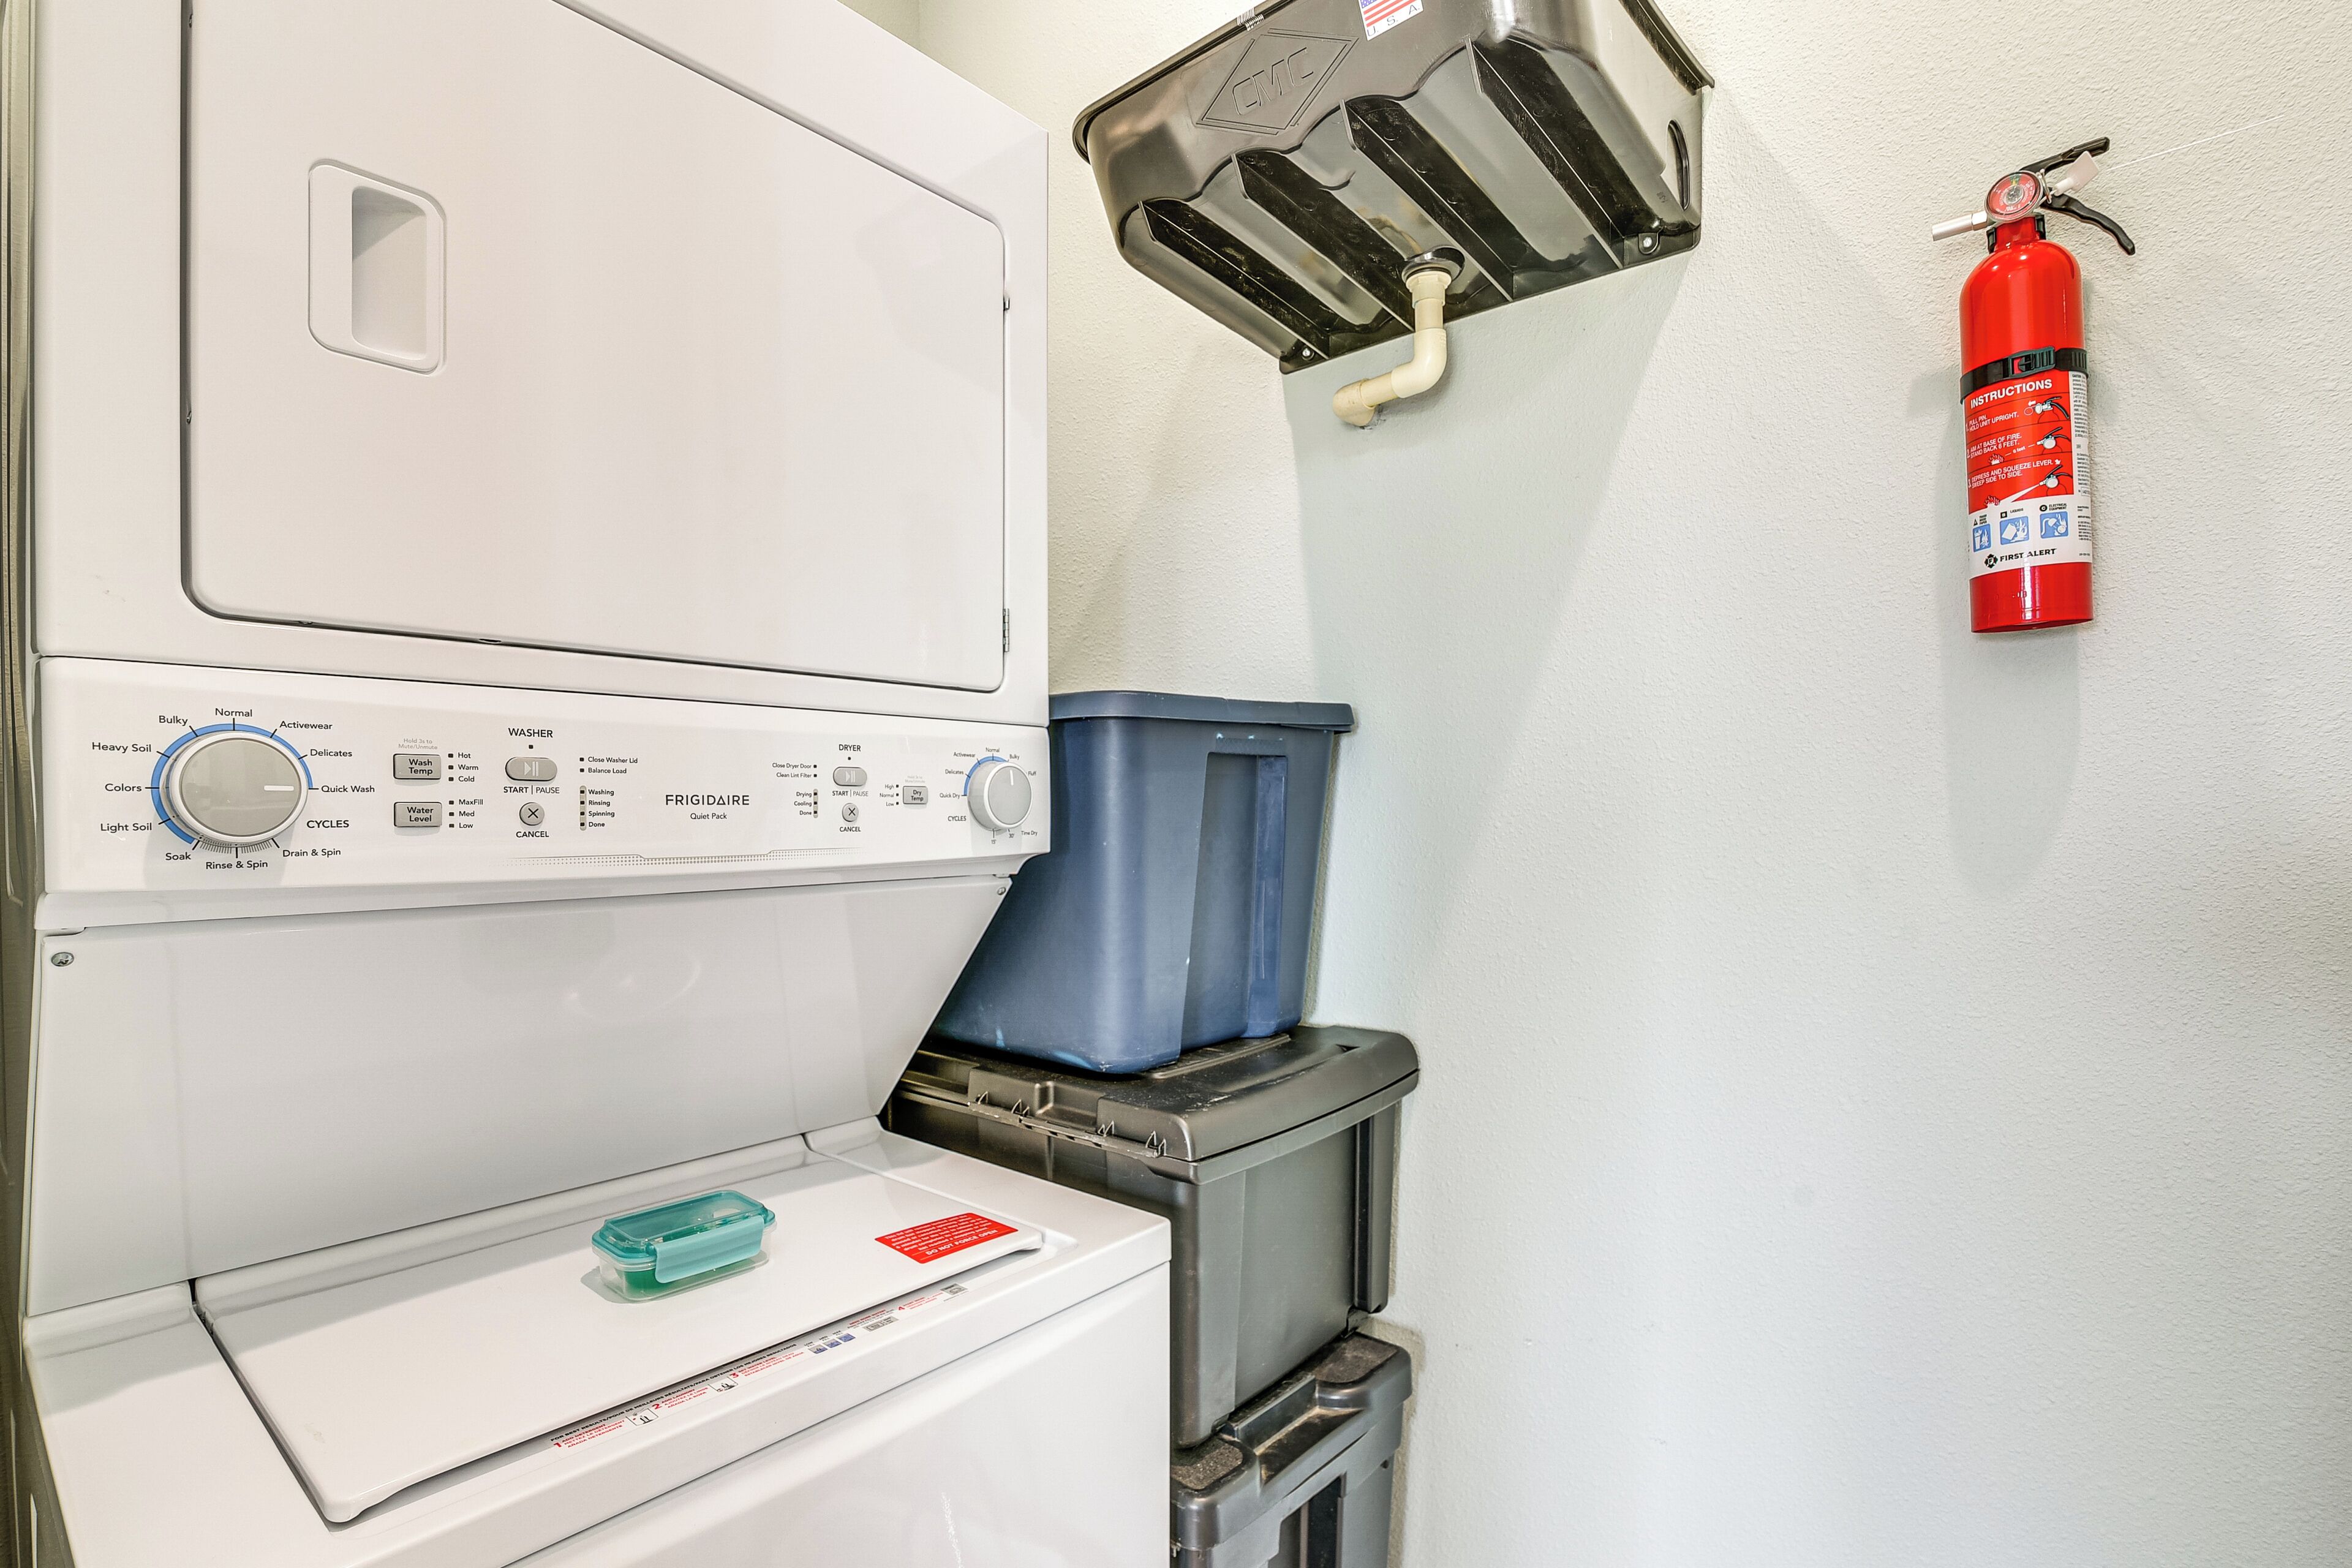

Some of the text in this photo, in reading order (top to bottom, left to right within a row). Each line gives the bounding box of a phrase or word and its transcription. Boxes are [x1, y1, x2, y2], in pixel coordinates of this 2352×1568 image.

[1367, 4, 1420, 37] U. S. A.
[1232, 47, 1314, 116] CMC
[1971, 379, 2052, 409] INSTRUCTIONS
[1969, 418, 1978, 426] PULL
[1969, 423, 1980, 432] HOLD
[1980, 419, 1991, 428] UNIT
[1992, 412, 2019, 424] UPRIGHT.
[1983, 439, 1997, 447] BASE
[1970, 450, 1983, 459] STAND
[1983, 445, 1997, 453] BACK
[1972, 472, 1989, 483] DEPRESS
[1991, 468, 2002, 477] AND
[2003, 462, 2031, 472] SQUEEZE
[1972, 480, 1985, 489] SWEEP
[2000, 552, 2024, 562] FIRST
[2026, 548, 2057, 557] ALERT
[215, 708, 252, 717] Normal
[159, 715, 188, 726] Bulky
[279, 720, 333, 730] Activewear
[508, 728, 554, 738] WASHER
[92, 742, 152, 753] Heavy Soil
[839, 744, 861, 752] DRYER
[408, 767, 433, 776] Temp
[105, 783, 142, 792] Colors
[321, 785, 348, 794] Quick
[665, 794, 750, 805] FRIGIDAIRE
[690, 812, 710, 821] Quiet
[100, 822, 153, 833] Light Soil
[306, 820, 350, 829] CYCLES
[165, 852, 192, 861] Soak
[282, 849, 310, 858] Drain
[322, 848, 341, 858] Spin
[205, 860, 268, 870] Rinse & Spin
[955, 1236, 977, 1245] FORCE
[980, 1229, 998, 1238] OPEN
